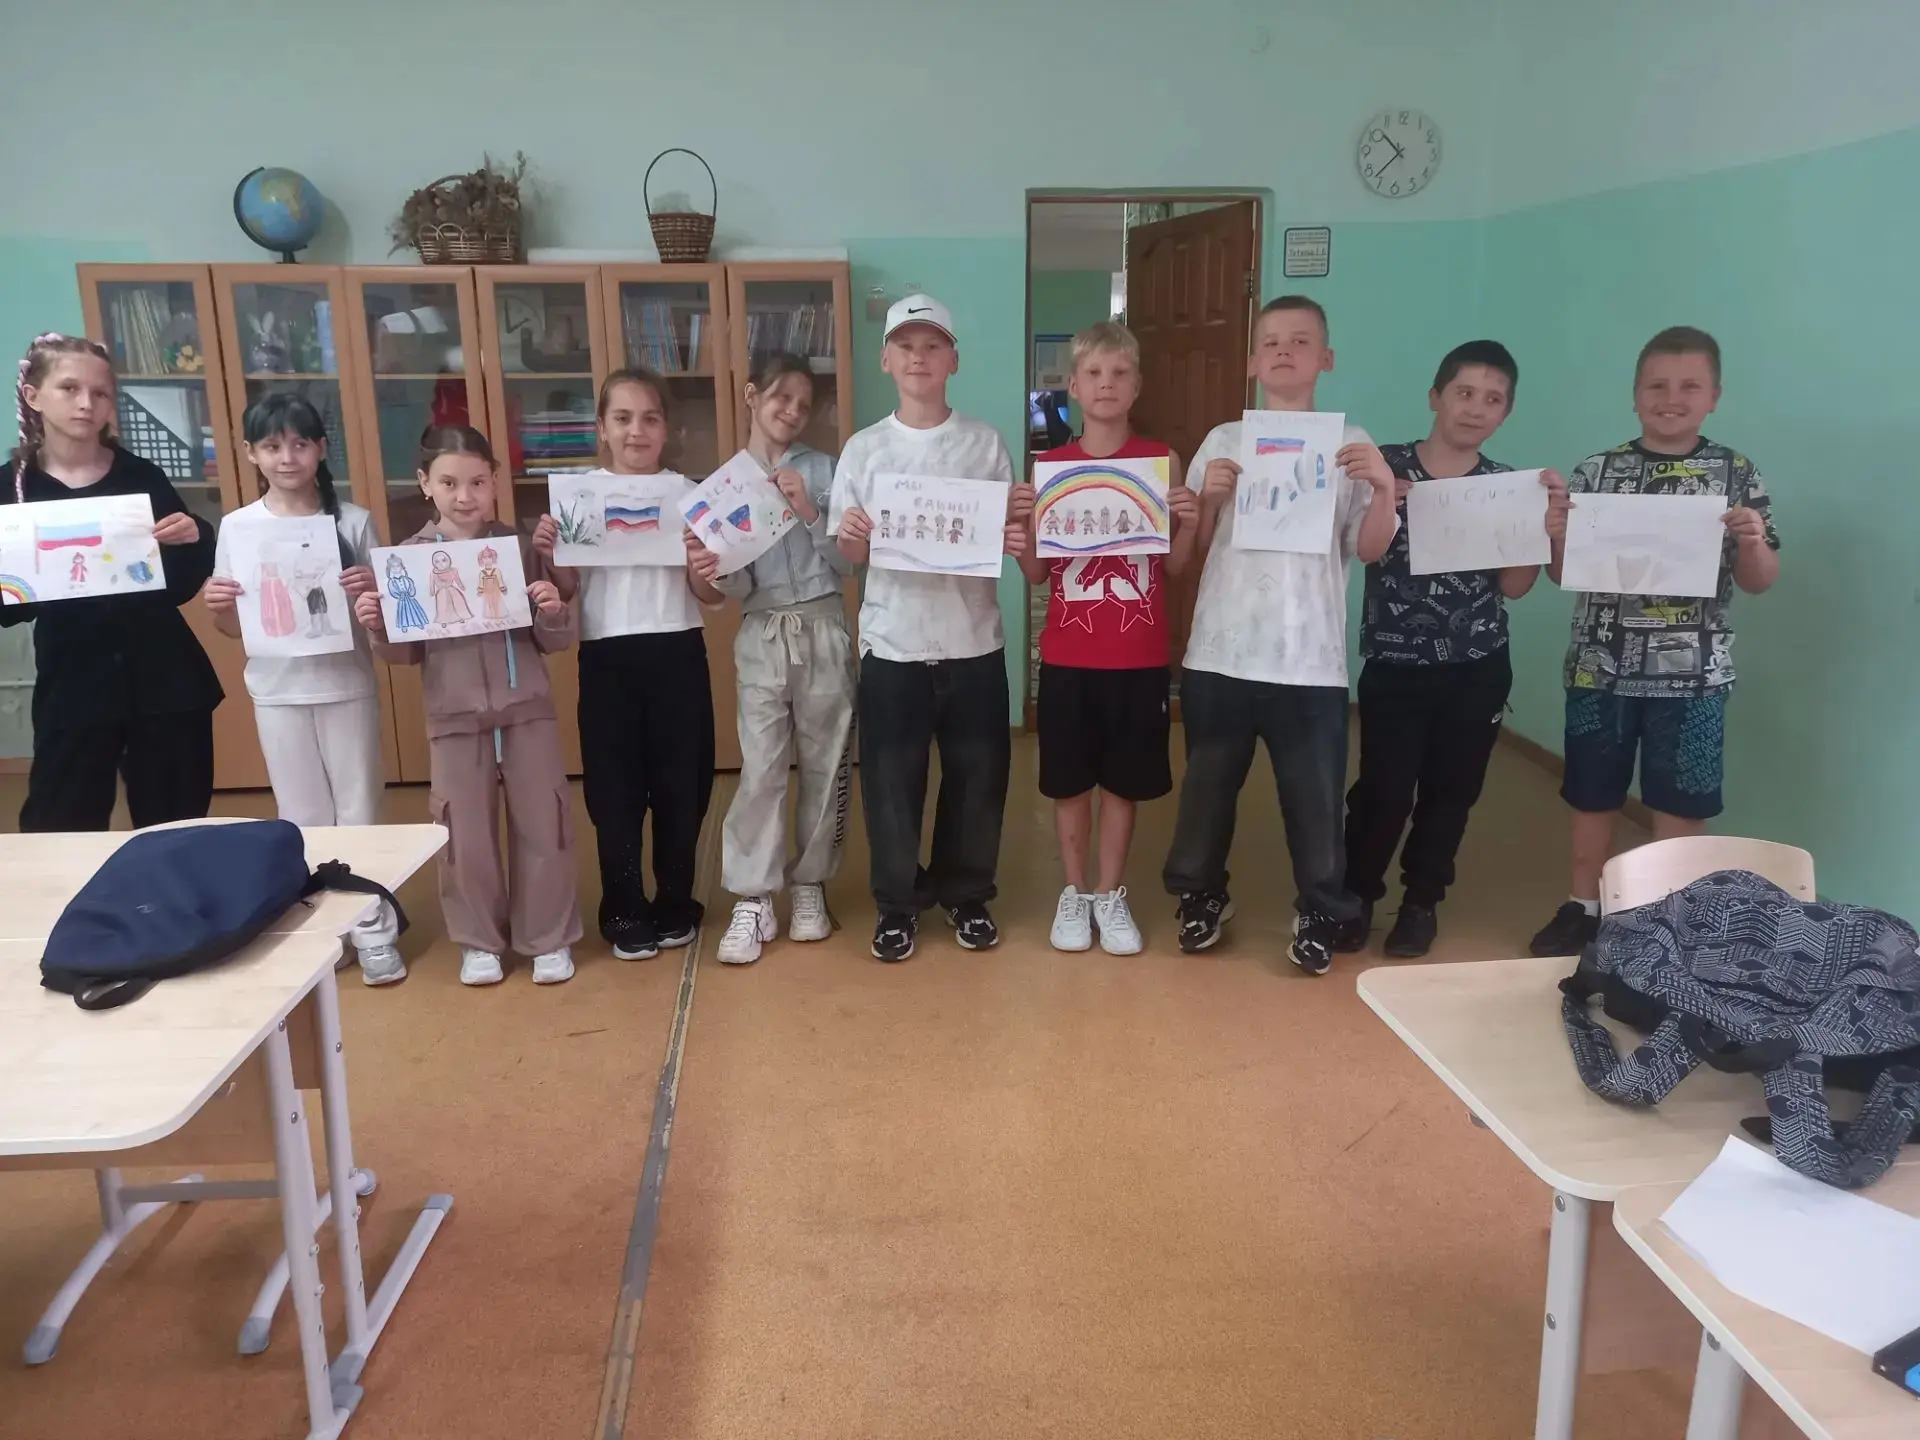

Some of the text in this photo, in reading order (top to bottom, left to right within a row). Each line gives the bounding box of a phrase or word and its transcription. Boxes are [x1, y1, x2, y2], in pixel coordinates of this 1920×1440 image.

[1399, 110, 1410, 125] 12
[1369, 128, 1384, 143] 10
[1426, 129, 1435, 143] 2
[1362, 144, 1371, 159] 9
[1430, 147, 1437, 162] 3
[1364, 163, 1374, 177] 8
[1422, 166, 1429, 179] 4
[1375, 176, 1383, 189] 7
[1390, 181, 1400, 195] 6
[1409, 177, 1416, 191] 5
